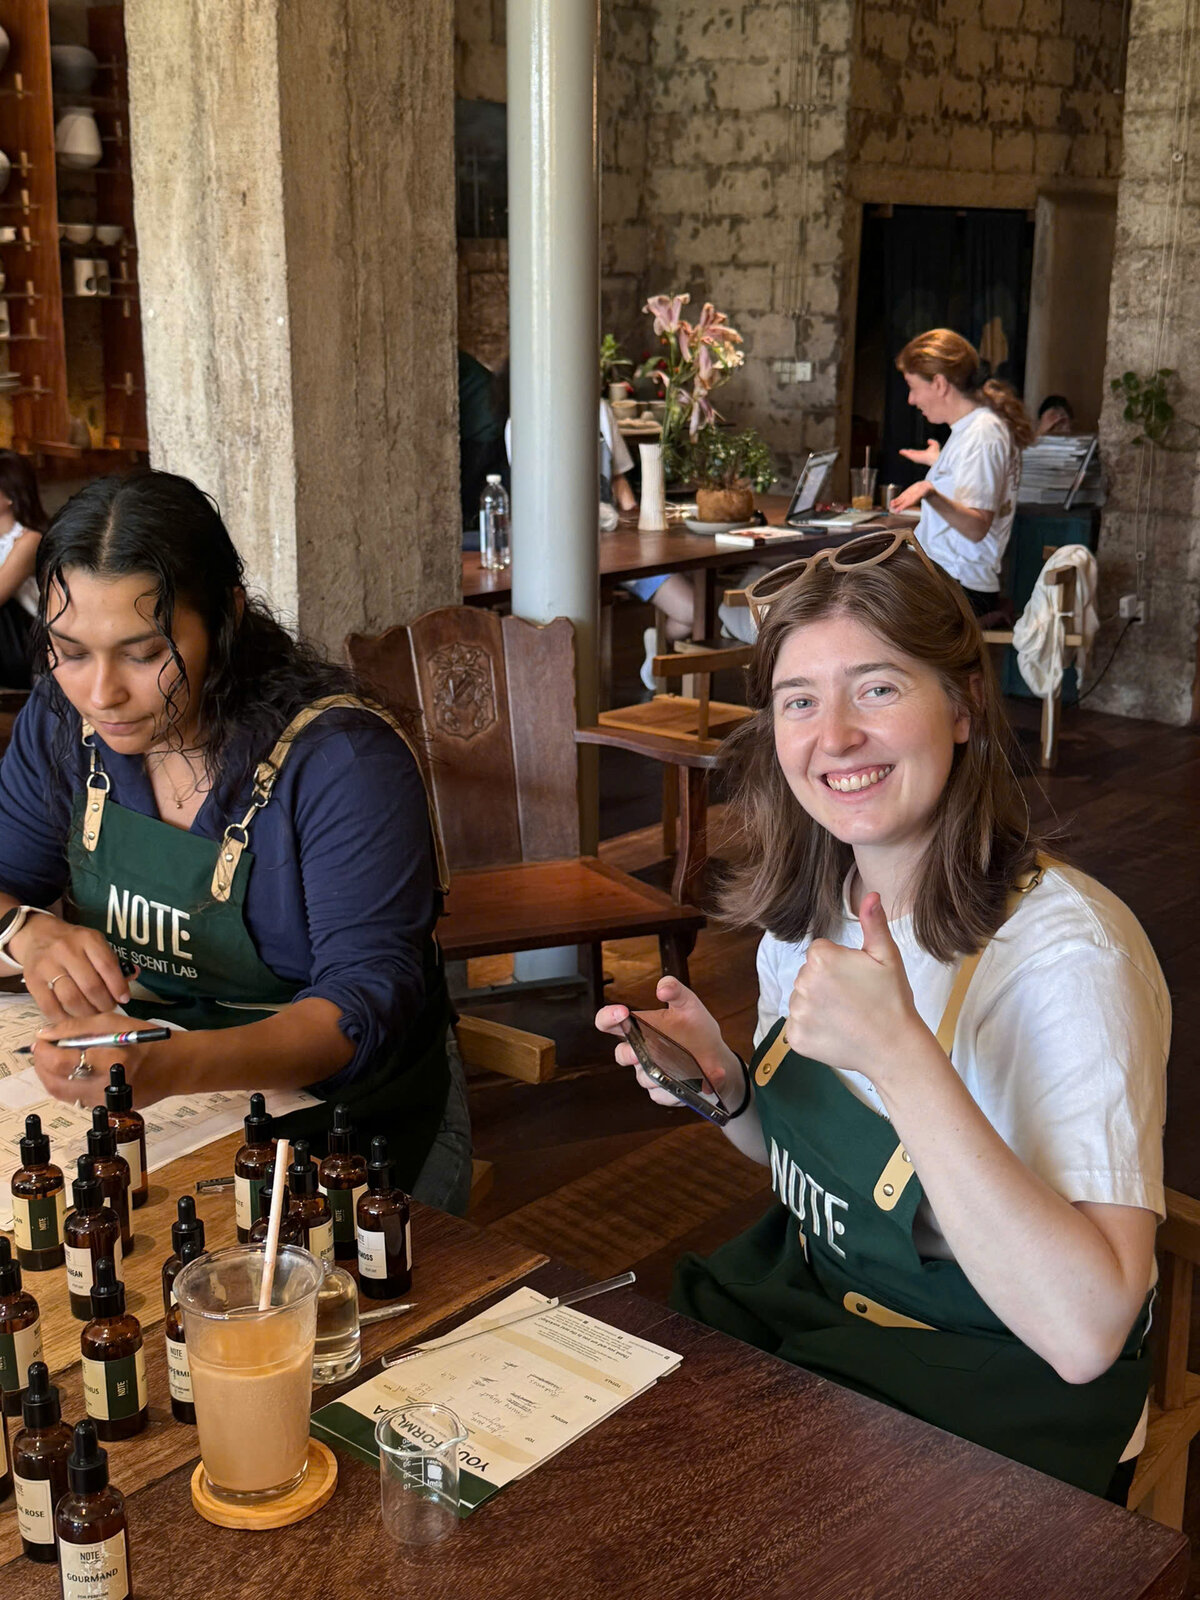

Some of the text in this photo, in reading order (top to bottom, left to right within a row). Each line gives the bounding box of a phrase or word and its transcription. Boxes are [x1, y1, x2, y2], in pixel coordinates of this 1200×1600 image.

[106, 883, 193, 961] NOTE
[130, 950, 169, 975] SCENT
[171, 963, 199, 979] LAB
[769, 1136, 849, 1260] NOTE
[24, 1508, 45, 1518] ROSE
[80, 1550, 101, 1561] NOTE
[66, 1567, 119, 1583] GOURMAND
